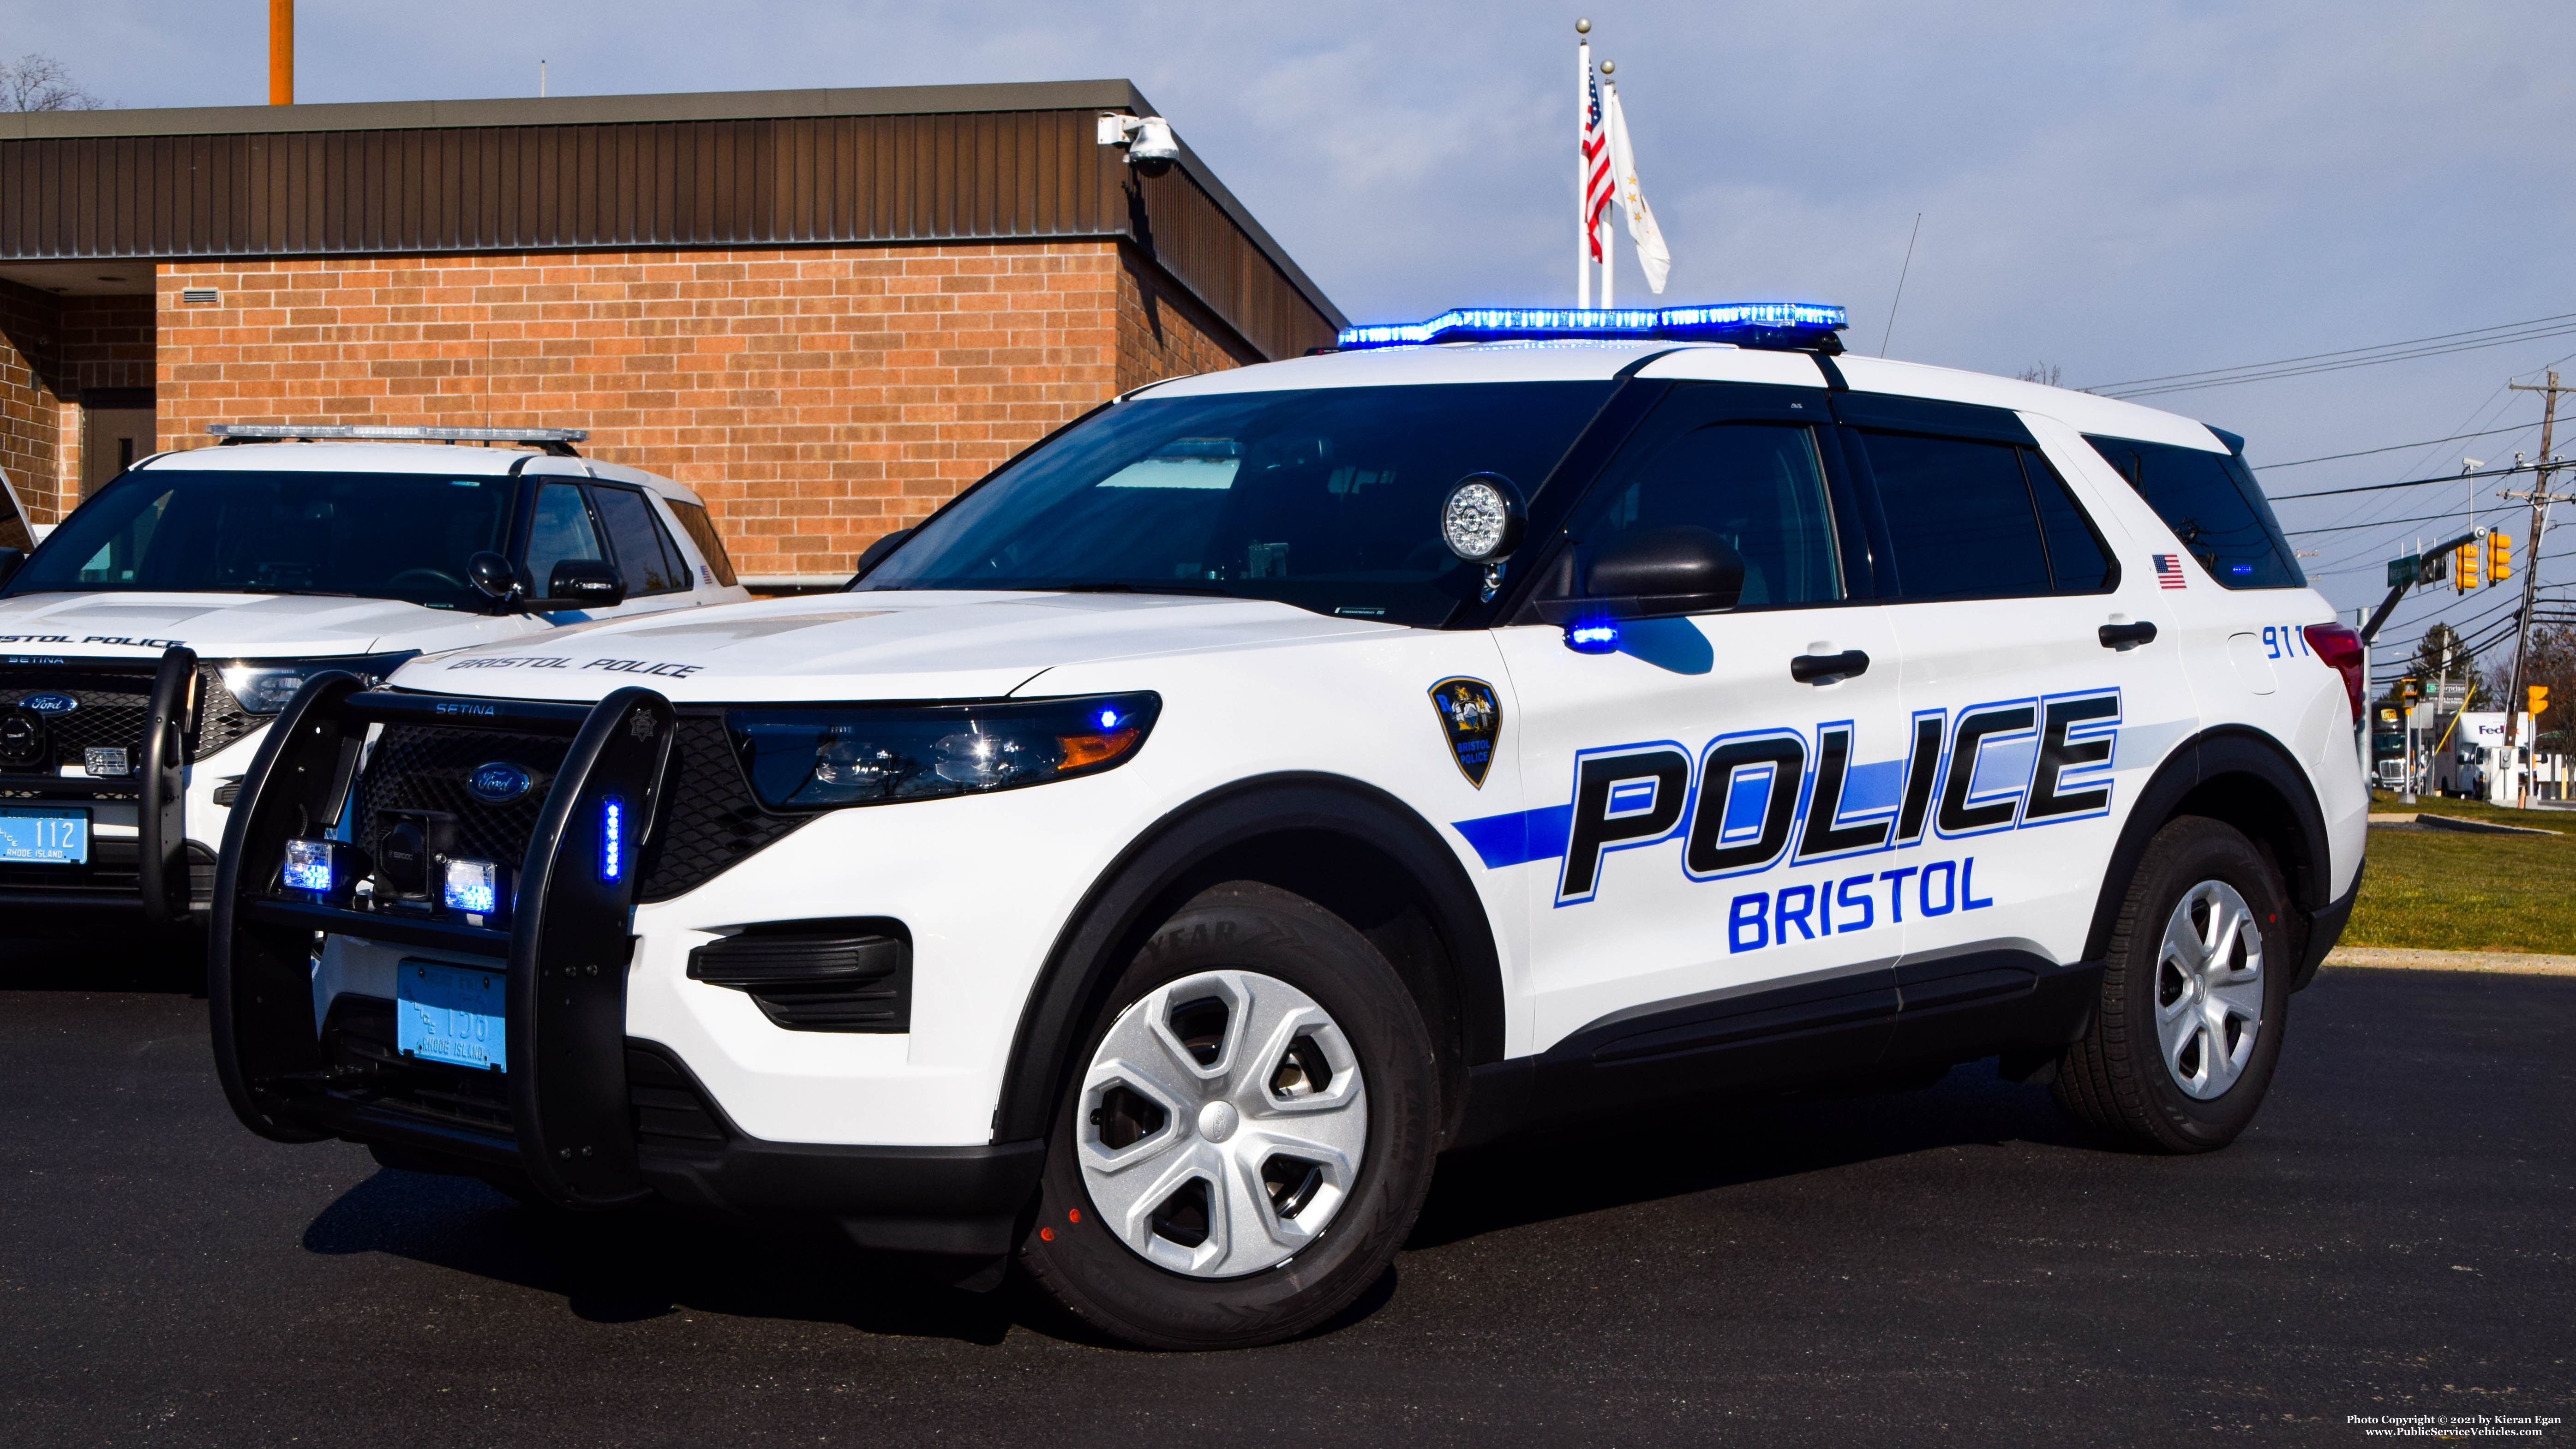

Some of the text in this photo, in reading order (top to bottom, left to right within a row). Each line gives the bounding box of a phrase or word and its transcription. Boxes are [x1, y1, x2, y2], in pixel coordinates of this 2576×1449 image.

[2262, 625, 2309, 659] 911
[445, 658, 705, 679] BRISTOL POLICE
[31, 697, 62, 709] Ford
[436, 703, 495, 716] SETINA
[1436, 694, 1453, 712] R
[2479, 725, 2520, 735] Fedx
[1457, 739, 1490, 753] BRISTOL
[1460, 751, 1488, 765] POLICE
[478, 771, 513, 791] Ford
[1553, 686, 2122, 908] POLICE
[36, 821, 74, 848] 112
[6, 849, 63, 858] RHODE ISLAND
[1729, 857, 1993, 954] BRISTOL
[422, 1037, 484, 1061] RHODE ISLAND
